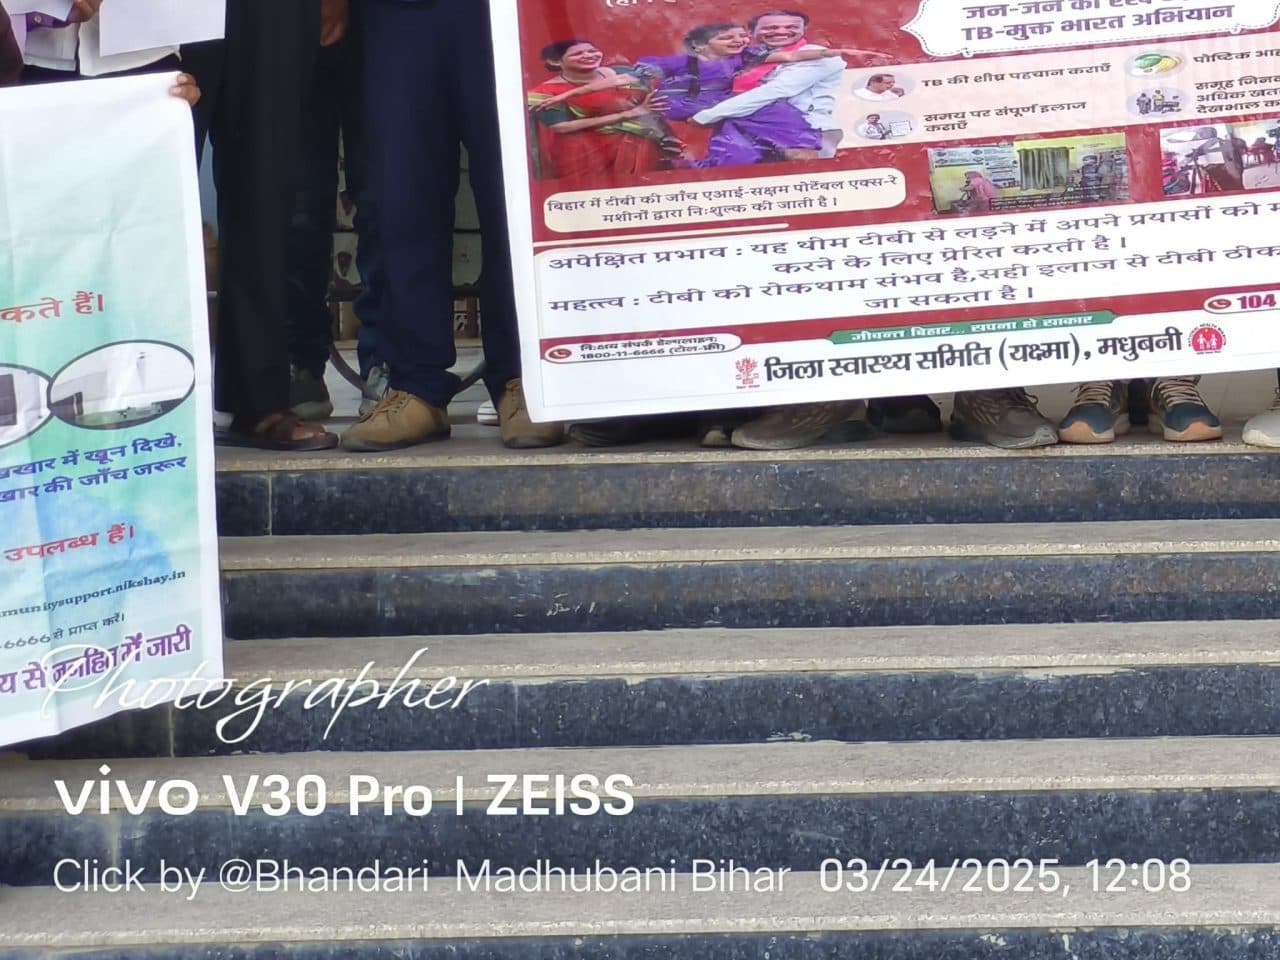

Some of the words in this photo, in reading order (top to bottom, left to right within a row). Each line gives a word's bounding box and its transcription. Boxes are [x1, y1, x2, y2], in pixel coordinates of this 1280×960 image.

[961, 20, 1055, 41] TB-मुक्त
[1061, 14, 1125, 31] भारत
[1132, 5, 1236, 26] अभियान
[962, 0, 1063, 20] जन-जन
[549, 251, 646, 271] अपेक्षित
[654, 245, 729, 263] प्रभाव
[750, 241, 789, 257] यह
[796, 234, 850, 250] थीम
[858, 229, 915, 247] टीबी
[923, 226, 949, 242] से
[954, 219, 1017, 240] लड़ने
[1023, 217, 1047, 234] में
[1055, 211, 1121, 232] अपने
[1127, 204, 1213, 227] प्रयासों
[1219, 201, 1260, 218] को
[0, 297, 63, 323] कते
[1236, 293, 1277, 310] 104
[763, 355, 825, 381] जिला
[828, 351, 911, 378] स्वास्थ्य
[916, 341, 993, 370] समिति
[1097, 326, 1184, 361] मधुबनी
[61, 450, 79, 467] में
[84, 445, 128, 464] खून
[43, 476, 73, 493] की
[79, 467, 129, 486] जाँच
[134, 456, 187, 475] जरूर
[4, 532, 100, 561] उपलब्ध
[53, 628, 64, 640] से
[68, 620, 98, 636] प्राप्त
[146, 624, 192, 657] जारी
